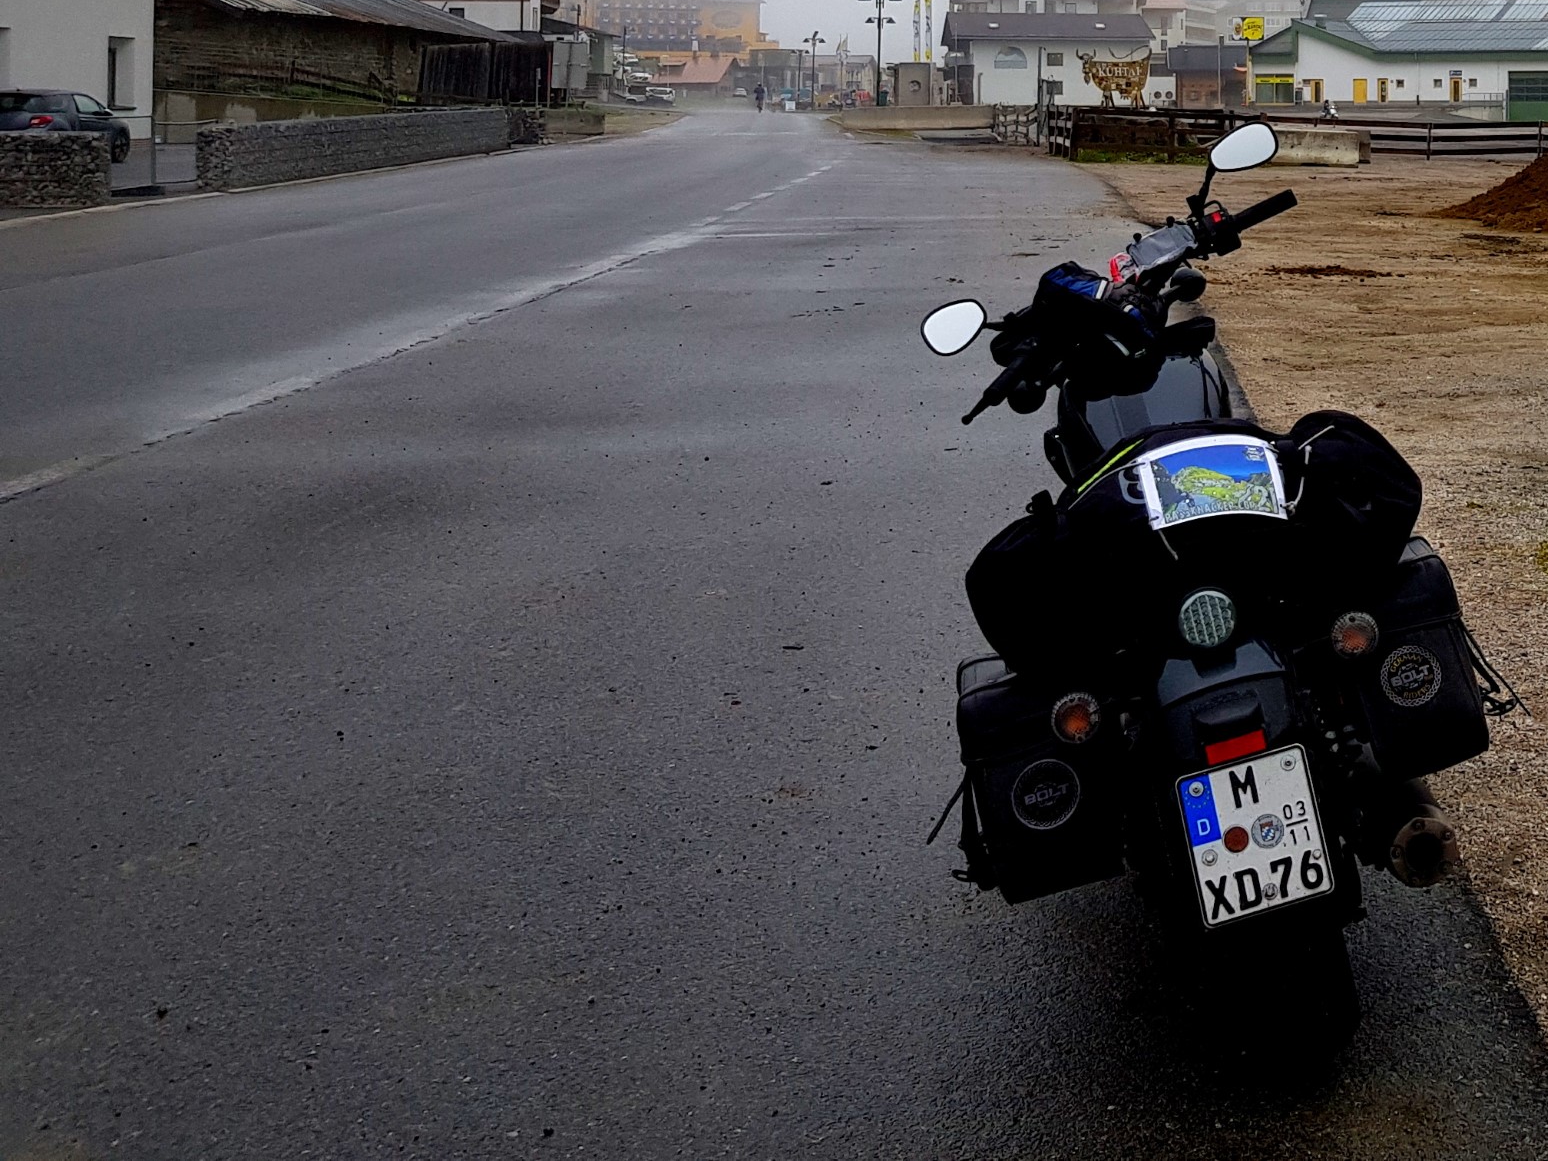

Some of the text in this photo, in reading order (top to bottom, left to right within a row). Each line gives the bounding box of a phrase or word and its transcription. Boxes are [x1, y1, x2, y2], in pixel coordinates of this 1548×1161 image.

[1390, 664, 1430, 687] BOLT
[1023, 782, 1070, 806] BOLT
[1229, 765, 1259, 809] M
[1282, 800, 1306, 820] 03
[1197, 818, 1211, 836] D
[1289, 826, 1311, 845] 11
